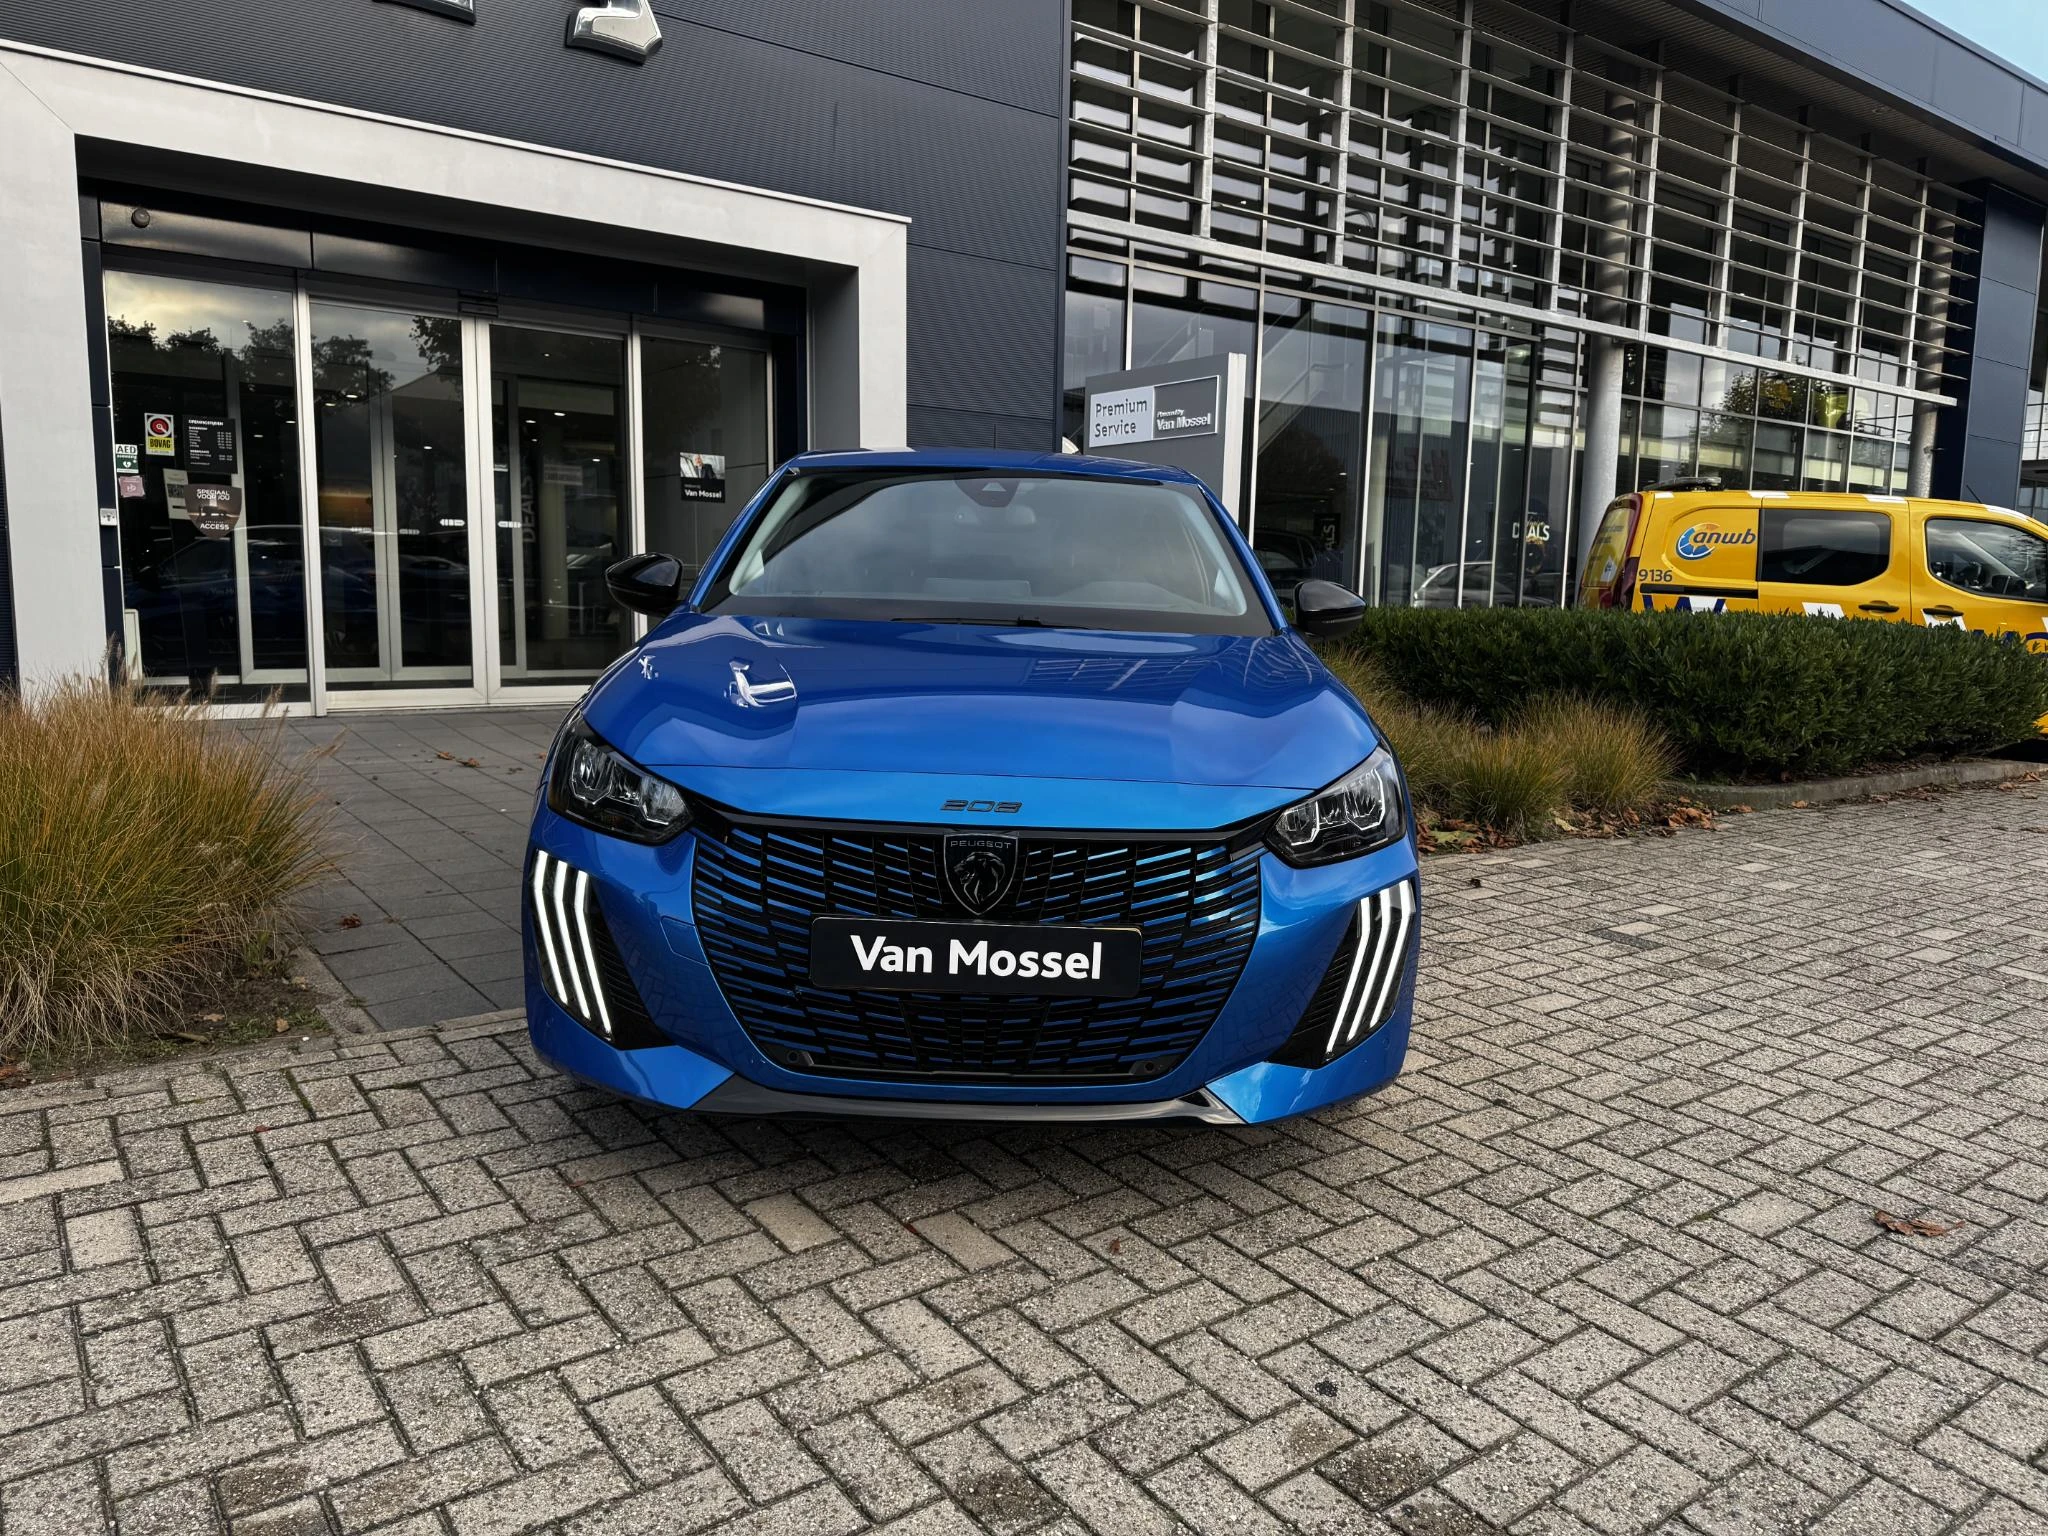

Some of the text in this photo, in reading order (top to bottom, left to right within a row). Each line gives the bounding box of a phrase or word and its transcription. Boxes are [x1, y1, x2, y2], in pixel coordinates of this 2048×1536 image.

[1095, 398, 1147, 417] Premium
[1094, 419, 1136, 438] Service
[1157, 413, 1211, 430] Van Mossel
[117, 445, 136, 454] AED
[196, 488, 230, 496] SPECIAAL
[684, 489, 722, 499] Van Mossel
[200, 523, 230, 531] ACCESS
[1512, 521, 1550, 542] DALS
[1692, 528, 1757, 545] anwb
[1638, 568, 1673, 582] 9136
[940, 799, 1023, 813] 208
[950, 840, 1012, 849] PEUGEOT
[850, 935, 1102, 979] Van Mossel
